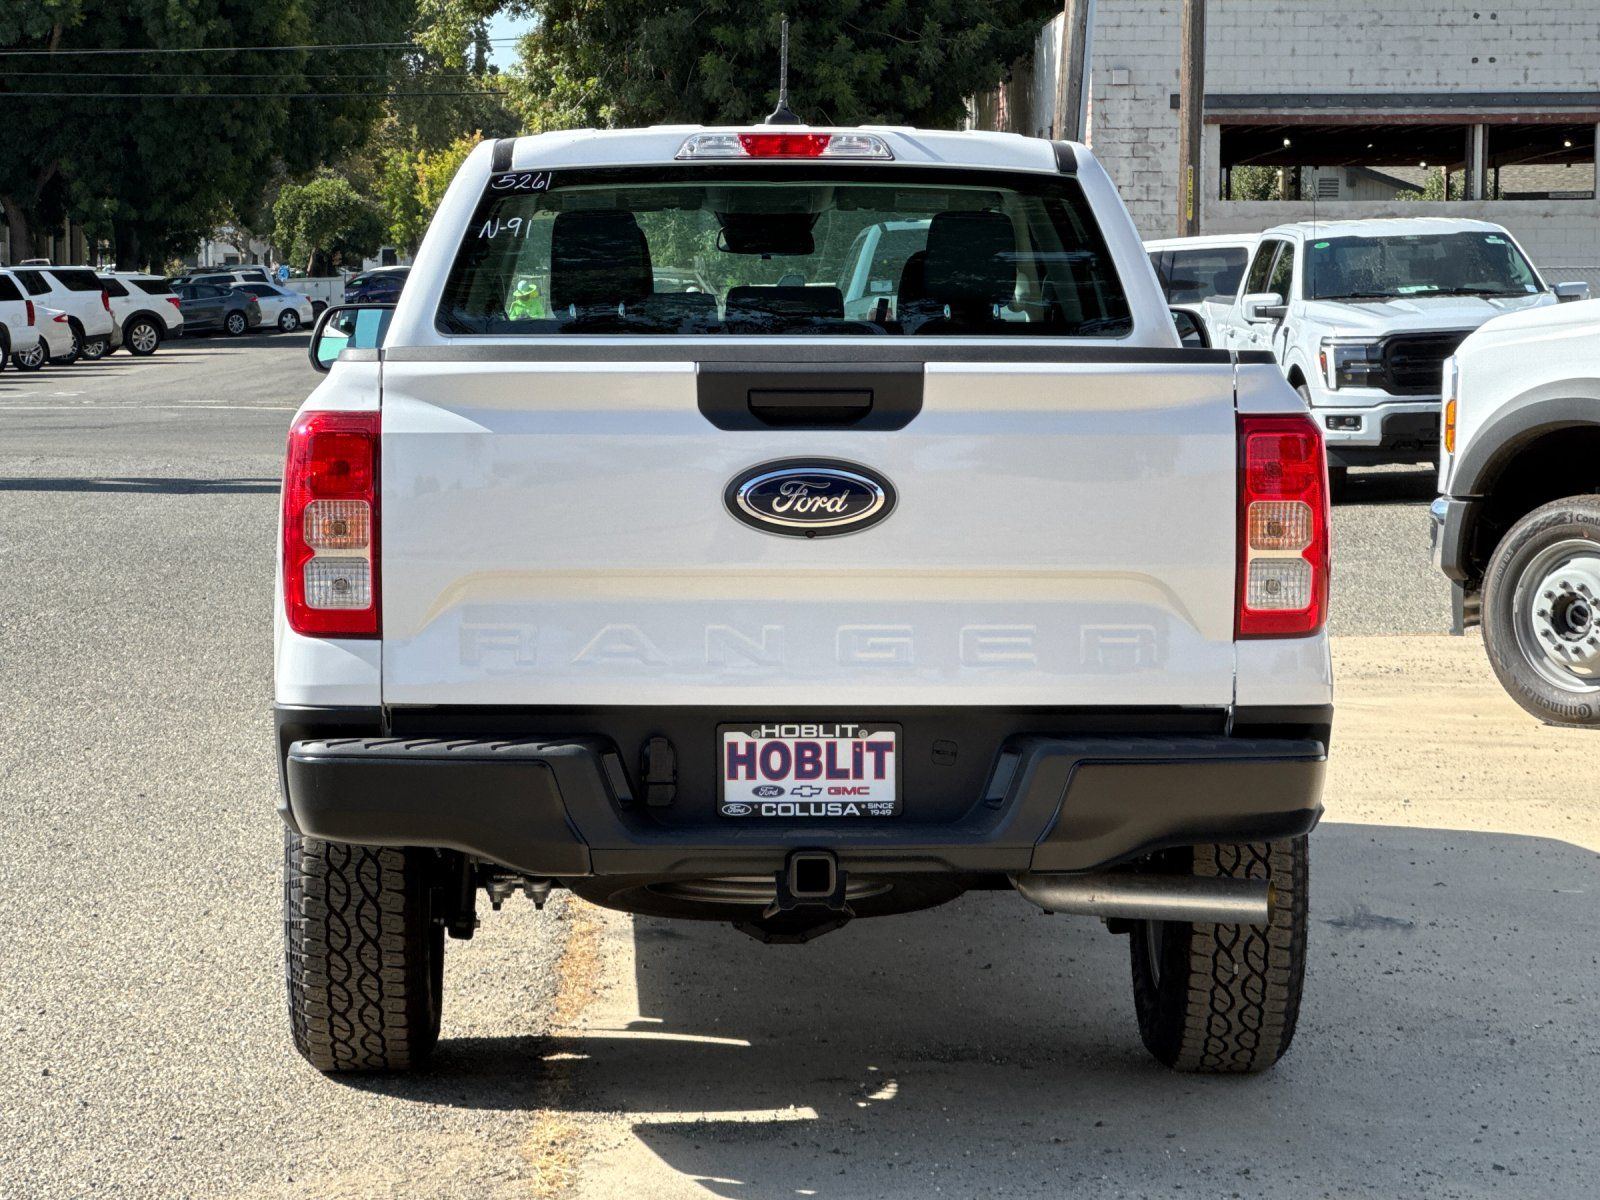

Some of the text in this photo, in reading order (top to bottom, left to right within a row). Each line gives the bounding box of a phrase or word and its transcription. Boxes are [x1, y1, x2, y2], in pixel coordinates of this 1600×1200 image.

[491, 172, 552, 191] 5261
[478, 217, 532, 239] N-91
[772, 480, 849, 513] Ford
[458, 622, 1159, 667] RANGER
[761, 724, 858, 738] HOBLIT
[827, 786, 870, 796] GMC
[761, 803, 861, 816] COLUSA
